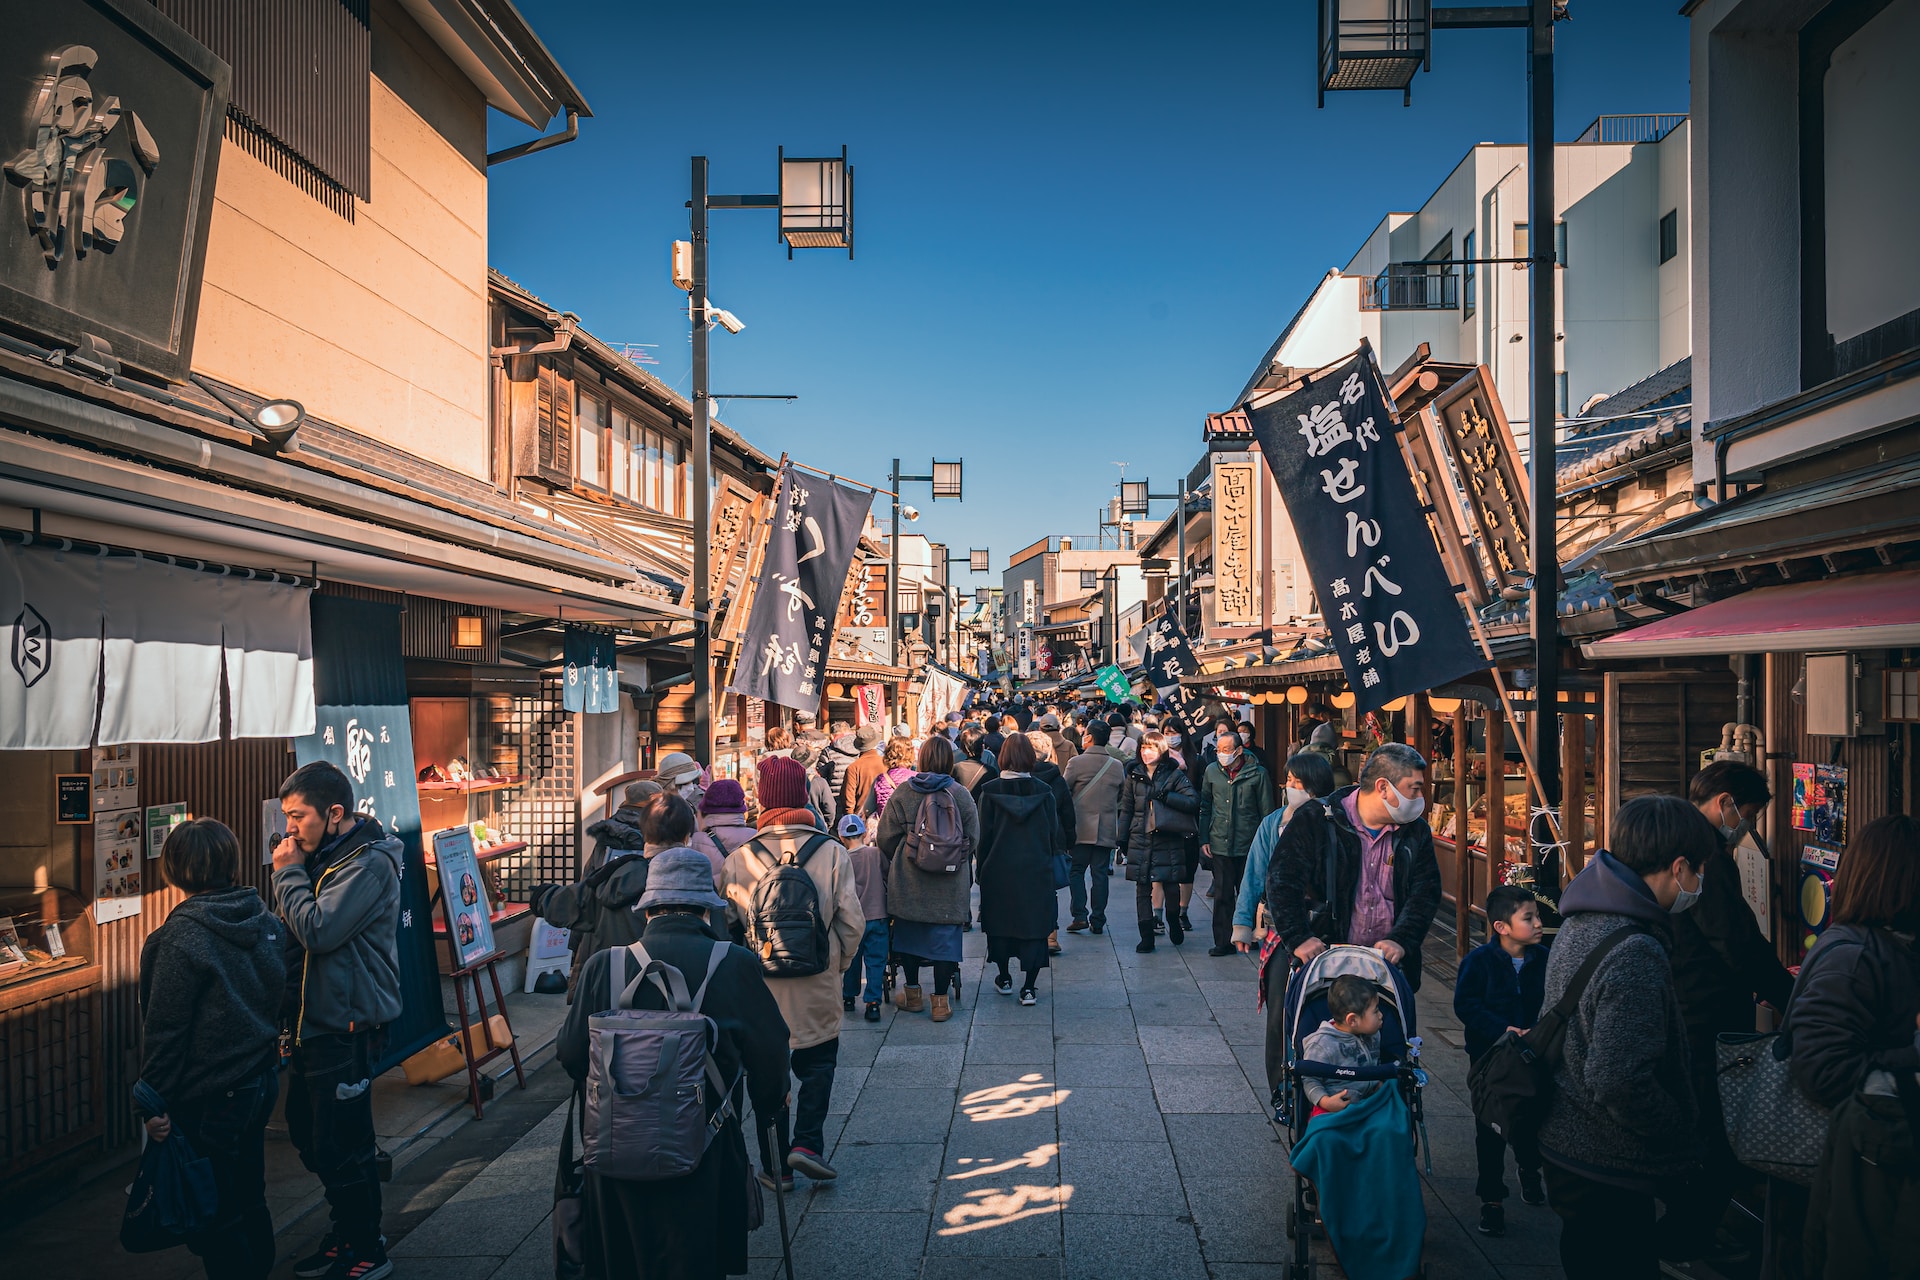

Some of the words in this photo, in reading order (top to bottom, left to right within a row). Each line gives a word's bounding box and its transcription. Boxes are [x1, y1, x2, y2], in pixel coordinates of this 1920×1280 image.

[1339, 372, 1381, 453] 名代
[1297, 399, 1421, 659] 塩せんべい
[1335, 1068, 1356, 1077] Aprica
